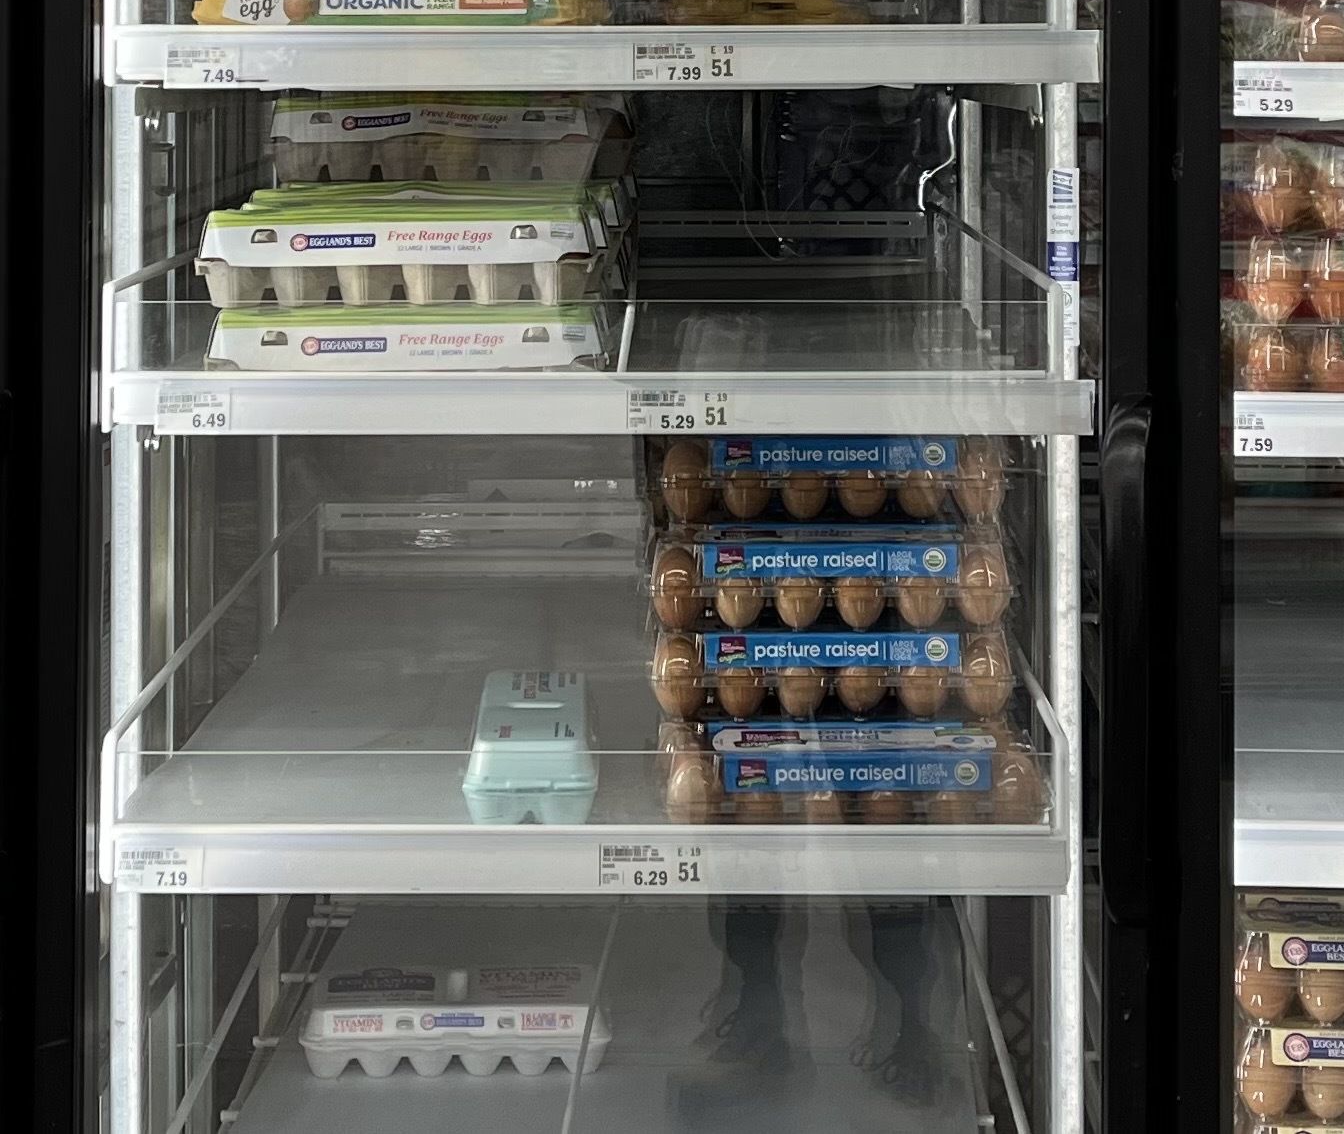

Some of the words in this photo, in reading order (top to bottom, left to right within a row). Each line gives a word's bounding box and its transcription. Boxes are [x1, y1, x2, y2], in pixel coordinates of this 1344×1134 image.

[710, 46, 716, 54] E
[724, 46, 734, 54] 19
[202, 68, 234, 82] 7.49
[668, 66, 702, 80] 7.99
[711, 58, 734, 77] 51
[1260, 98, 1294, 112] 5.29
[420, 108, 446, 118] Free
[446, 110, 478, 121] Range
[480, 110, 508, 124] Eggs
[354, 236, 374, 246] BEST
[388, 230, 416, 241] Free
[418, 230, 460, 244] Range
[462, 230, 492, 244] Eggs
[365, 340, 386, 350] BEST
[399, 334, 428, 346] Free
[430, 334, 470, 348] Range
[474, 334, 504, 348] Eggs
[704, 392, 710, 402] E
[716, 392, 728, 402] 19
[192, 413, 226, 428] 6.49
[660, 414, 695, 429] 5.29
[705, 406, 728, 426] 51
[1240, 438, 1273, 452] 7.59
[759, 448, 823, 464] pasture
[827, 446, 878, 462] raised
[752, 554, 818, 572] pasture
[822, 552, 877, 568] raised
[754, 644, 820, 660] pasture
[825, 641, 879, 657] raised
[774, 768, 846, 784] pasture
[850, 764, 906, 781] raised
[156, 871, 188, 886] 7.19
[634, 870, 668, 886] 6.29
[678, 862, 700, 882] 51
